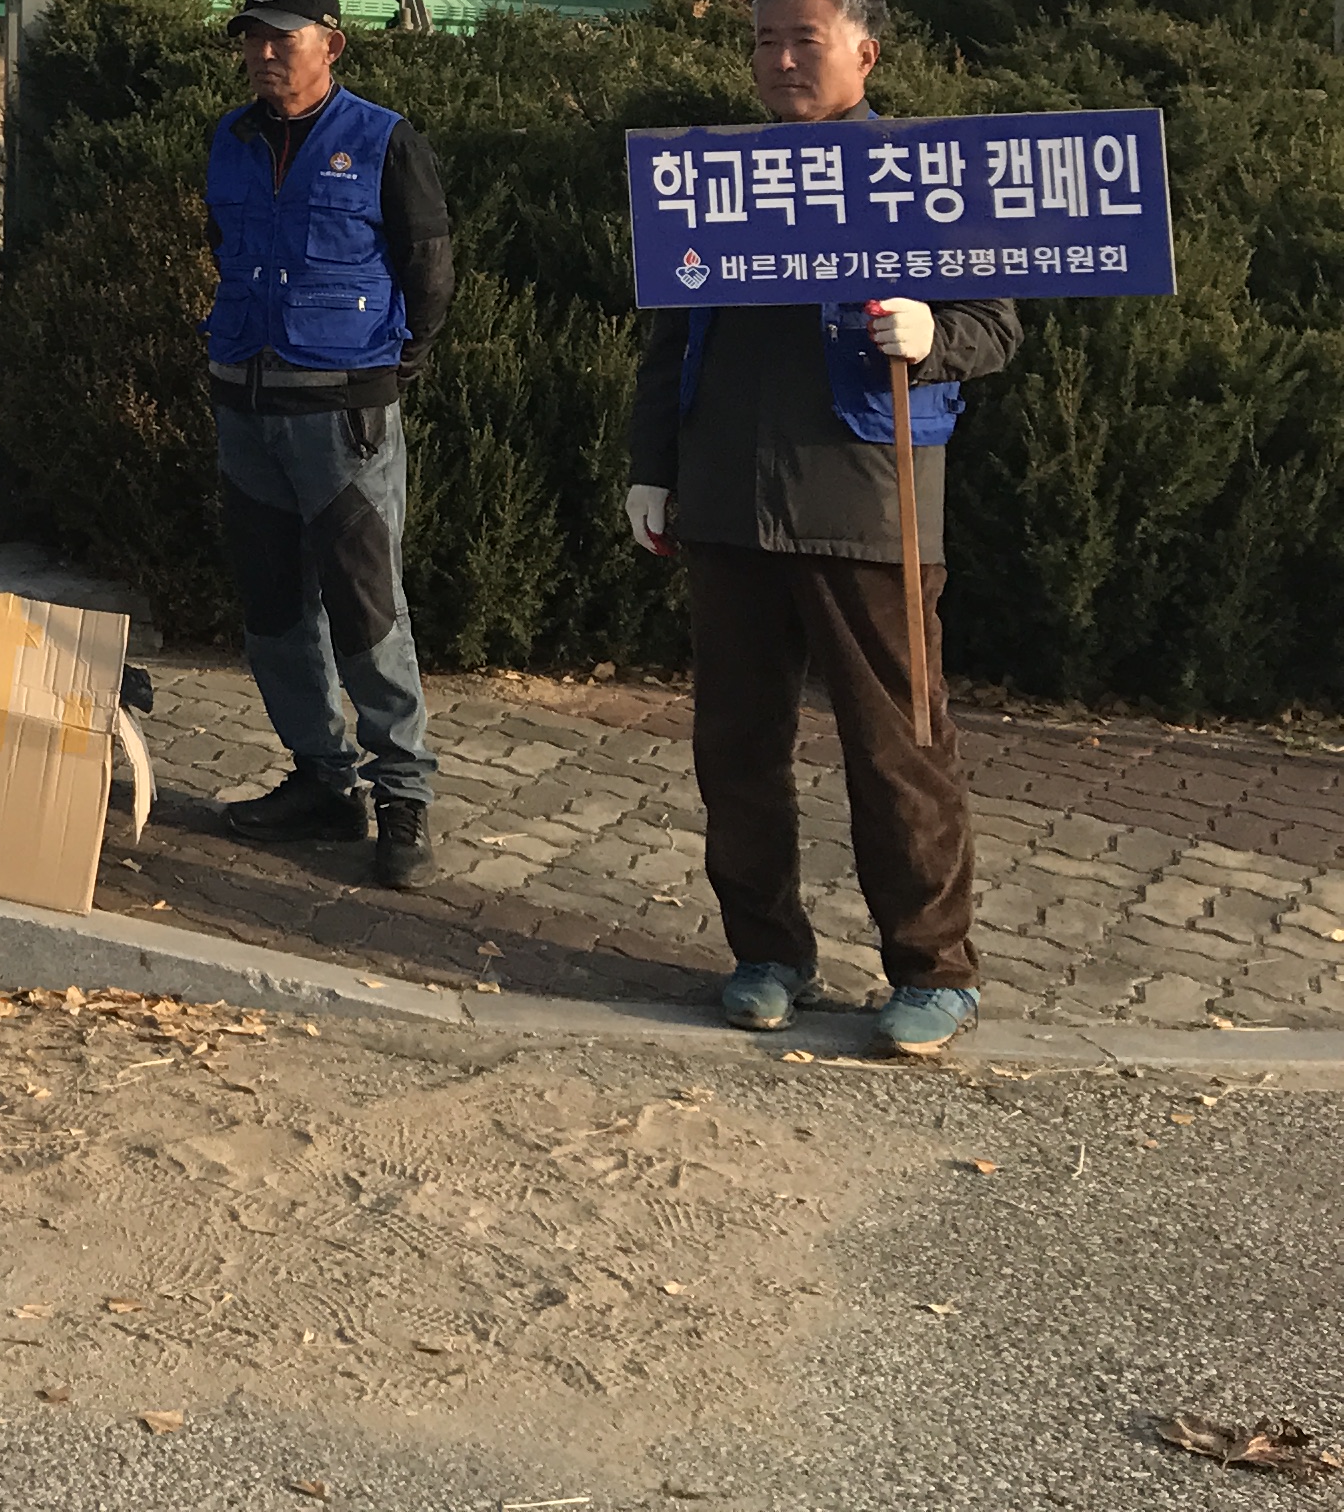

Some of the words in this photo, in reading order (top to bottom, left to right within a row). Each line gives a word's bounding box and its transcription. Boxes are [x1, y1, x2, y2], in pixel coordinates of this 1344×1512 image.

[651, 144, 847, 228] 학교폭력
[868, 140, 966, 223] 추방
[986, 134, 1143, 219] 캠페인
[720, 244, 1129, 282] 바르게살기운동장평면위원회
